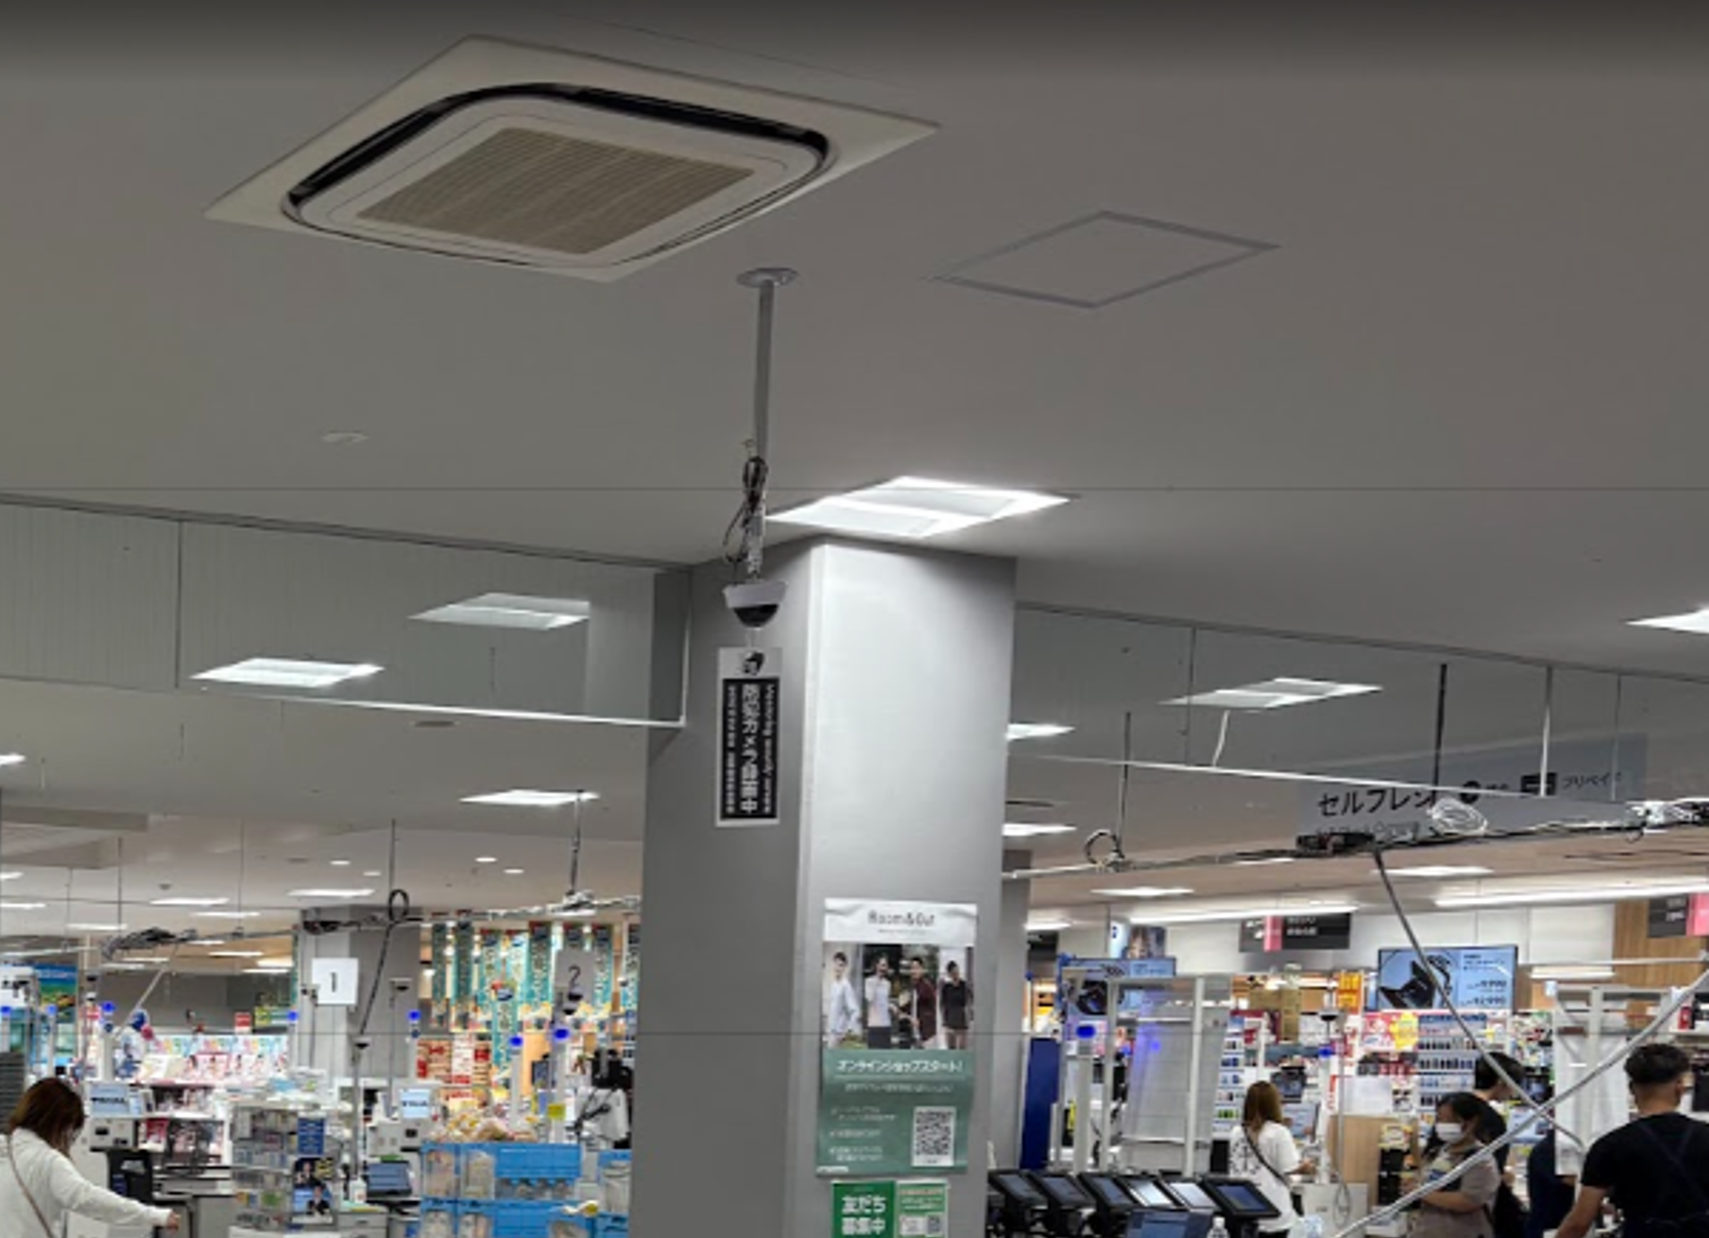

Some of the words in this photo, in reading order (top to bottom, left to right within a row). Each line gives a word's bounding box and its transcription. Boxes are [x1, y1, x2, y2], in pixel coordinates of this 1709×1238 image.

[330, 971, 337, 993] 1
[842, 1194, 888, 1216] 友だち
